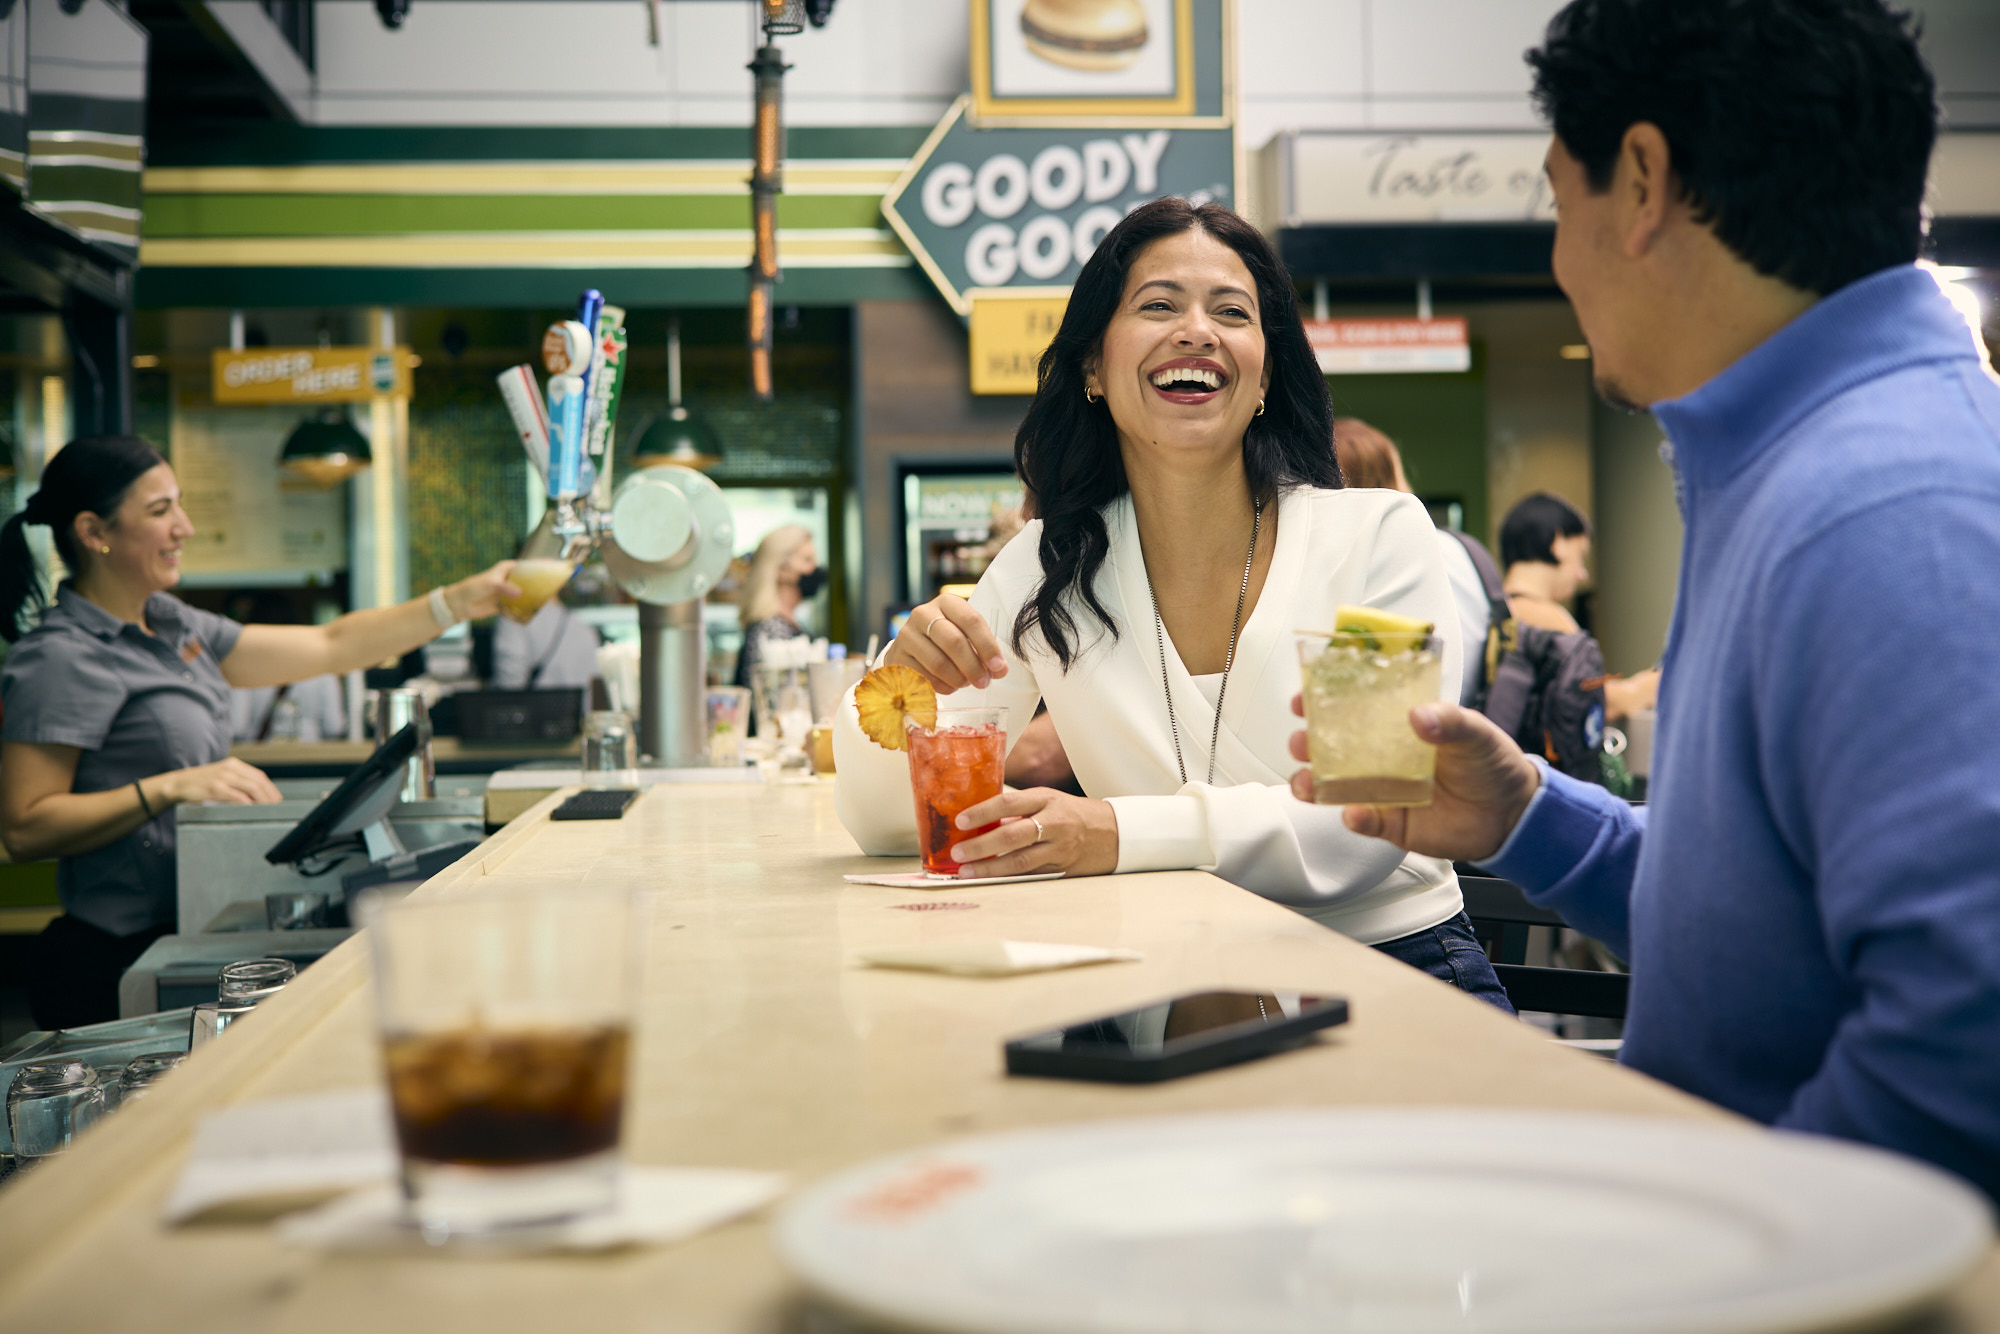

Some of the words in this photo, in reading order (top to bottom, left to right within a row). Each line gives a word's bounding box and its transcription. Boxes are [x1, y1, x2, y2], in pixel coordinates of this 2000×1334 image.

[921, 131, 1171, 227] GOODY
[1361, 134, 1492, 199] Taste
[223, 352, 314, 388] ORDER
[293, 363, 361, 396] HERE
